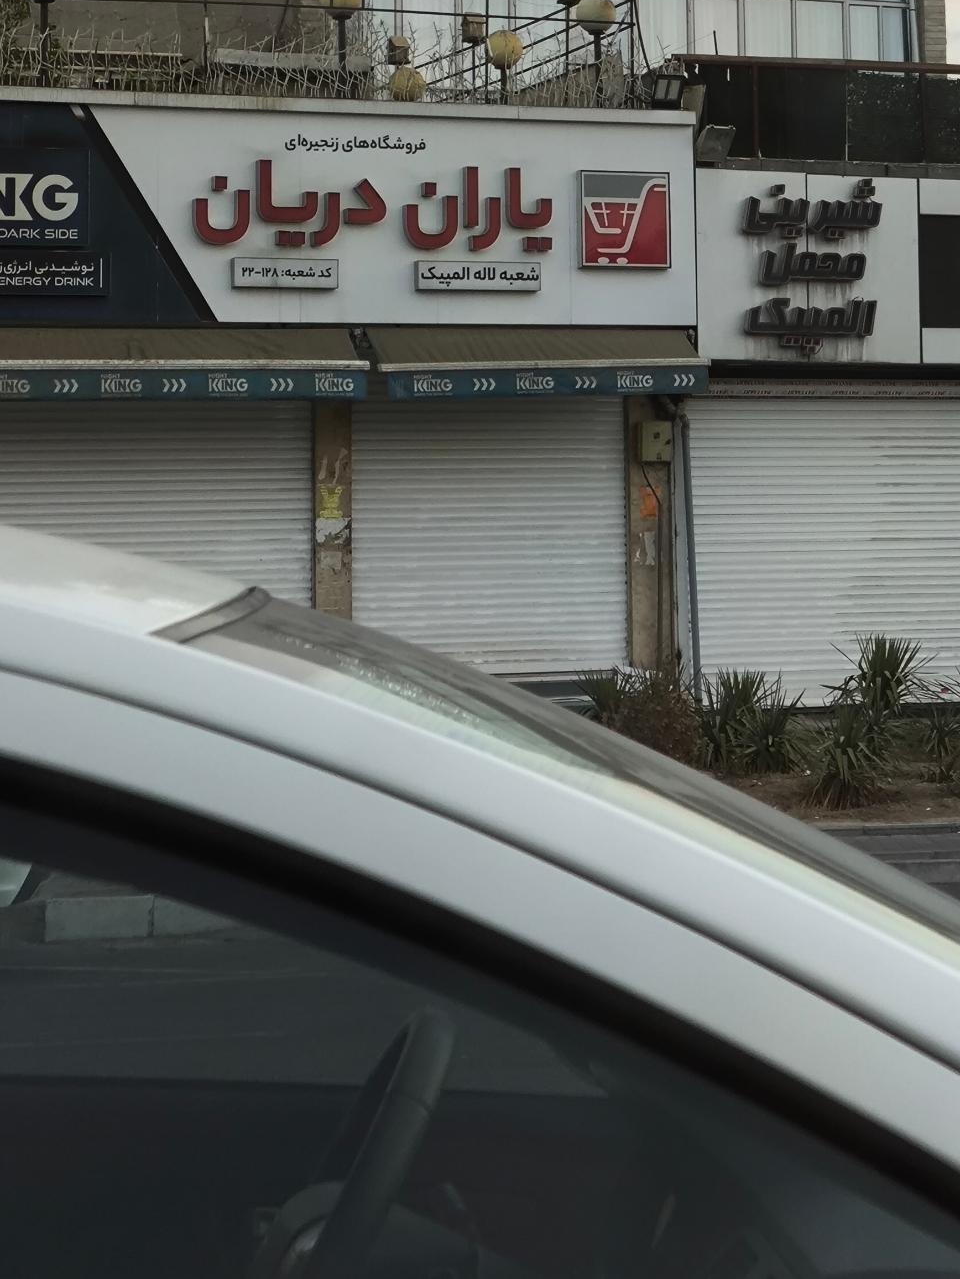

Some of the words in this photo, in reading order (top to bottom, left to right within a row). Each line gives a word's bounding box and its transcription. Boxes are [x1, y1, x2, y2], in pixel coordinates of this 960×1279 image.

[191, 158, 388, 246] دریان
[402, 165, 553, 251] یاران
[44, 228, 79, 240] SIDE
[34, 260, 95, 275] نوشیدنی
[317, 267, 332, 278] کد
[473, 266, 496, 281] لاله
[0, 277, 51, 287] ENERGY
[54, 277, 95, 287] DRINK
[420, 266, 470, 287] المپیک
[499, 267, 539, 285] شعبه
[744, 296, 878, 353] المپیک
[0, 378, 31, 394] ING
[101, 378, 143, 393] KING
[208, 378, 249, 392] KING
[315, 378, 354, 392] KING
[413, 378, 453, 393] KING
[516, 376, 555, 390] KING
[617, 374, 654, 388] KING
